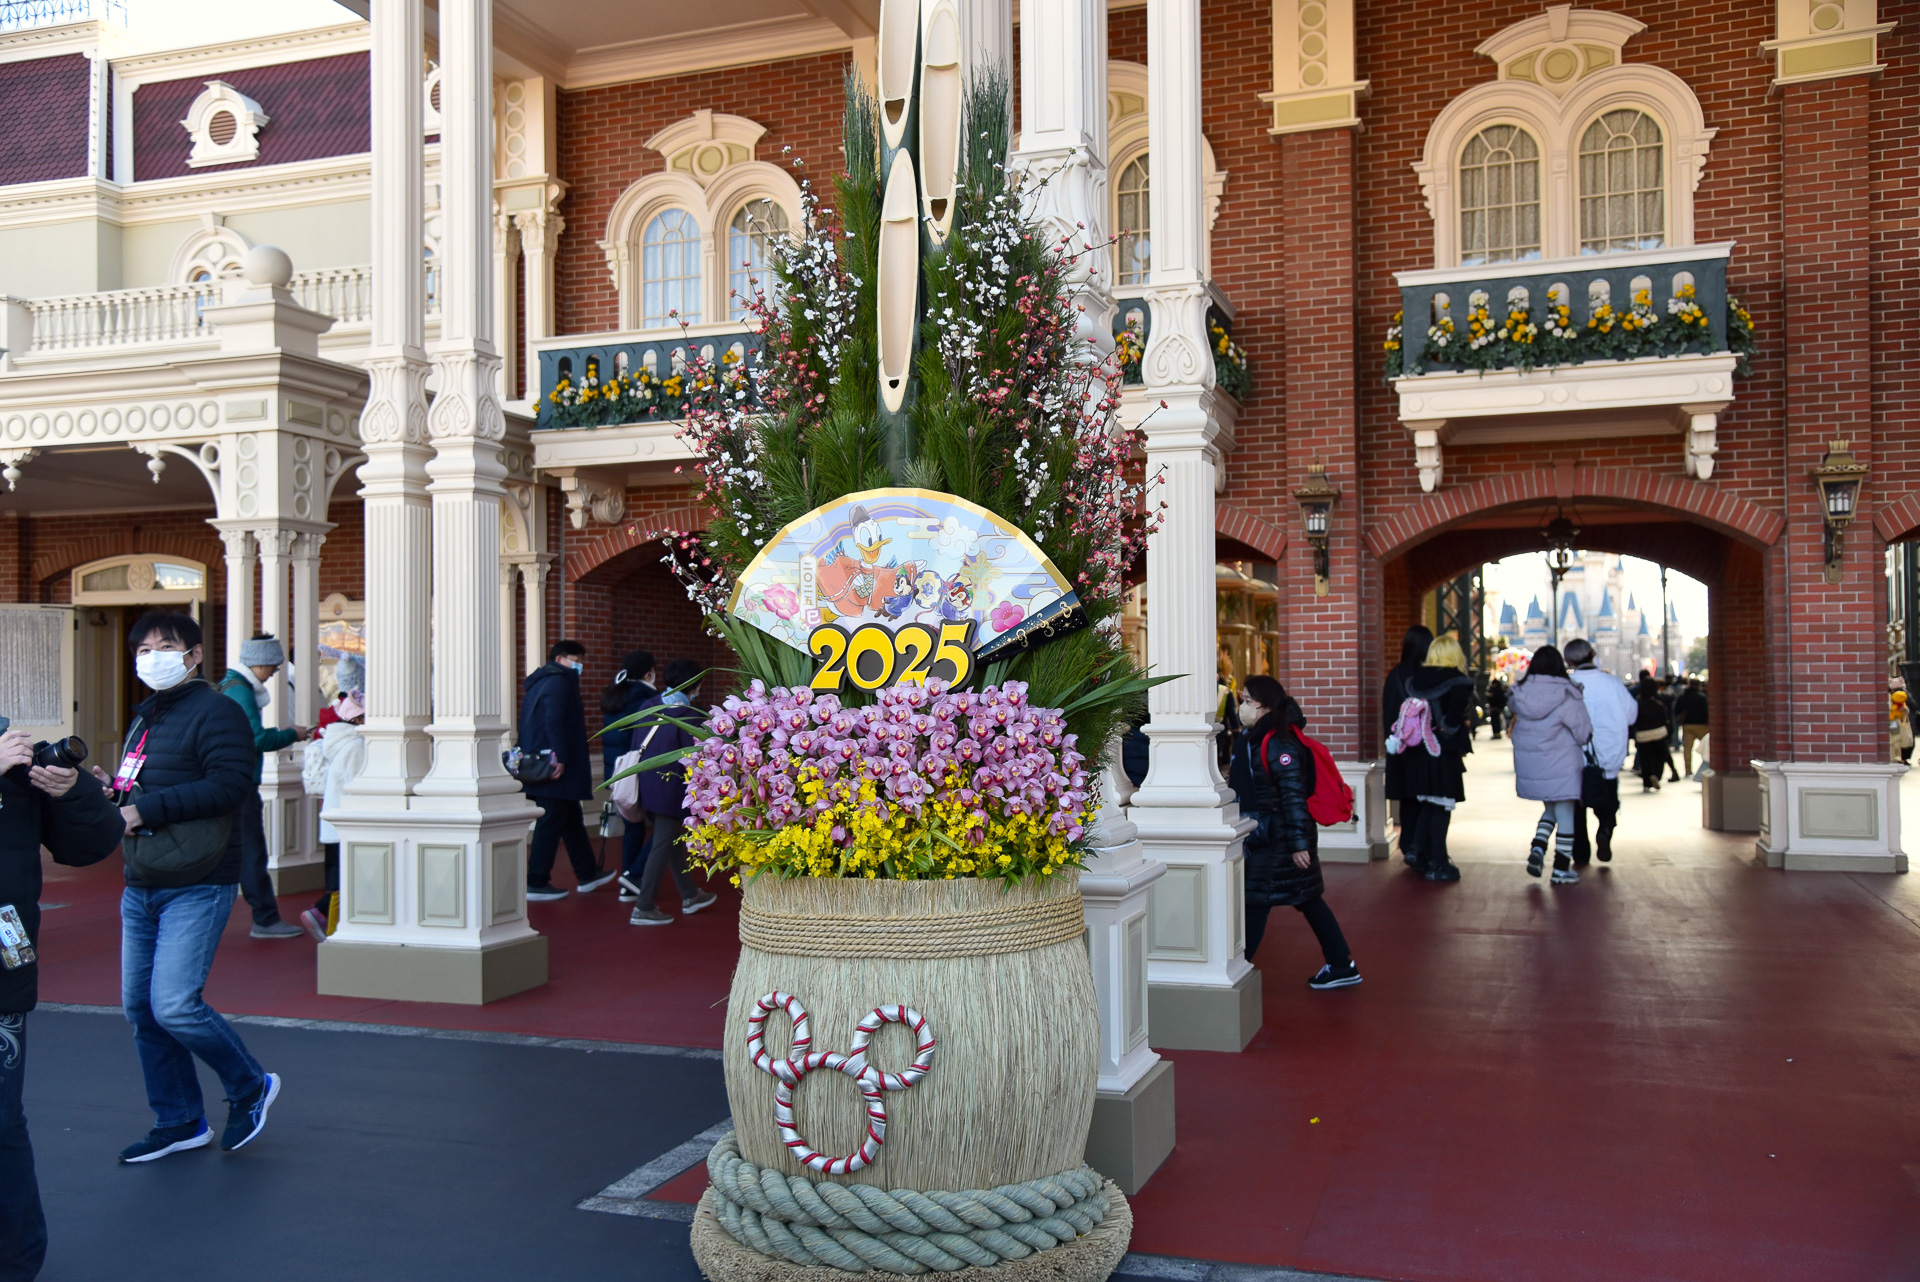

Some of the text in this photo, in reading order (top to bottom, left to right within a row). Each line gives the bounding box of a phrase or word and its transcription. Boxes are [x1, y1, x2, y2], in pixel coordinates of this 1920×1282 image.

[803, 562, 814, 606] 二〇二五
[810, 622, 970, 690] 2025
[122, 756, 145, 769] PRES
